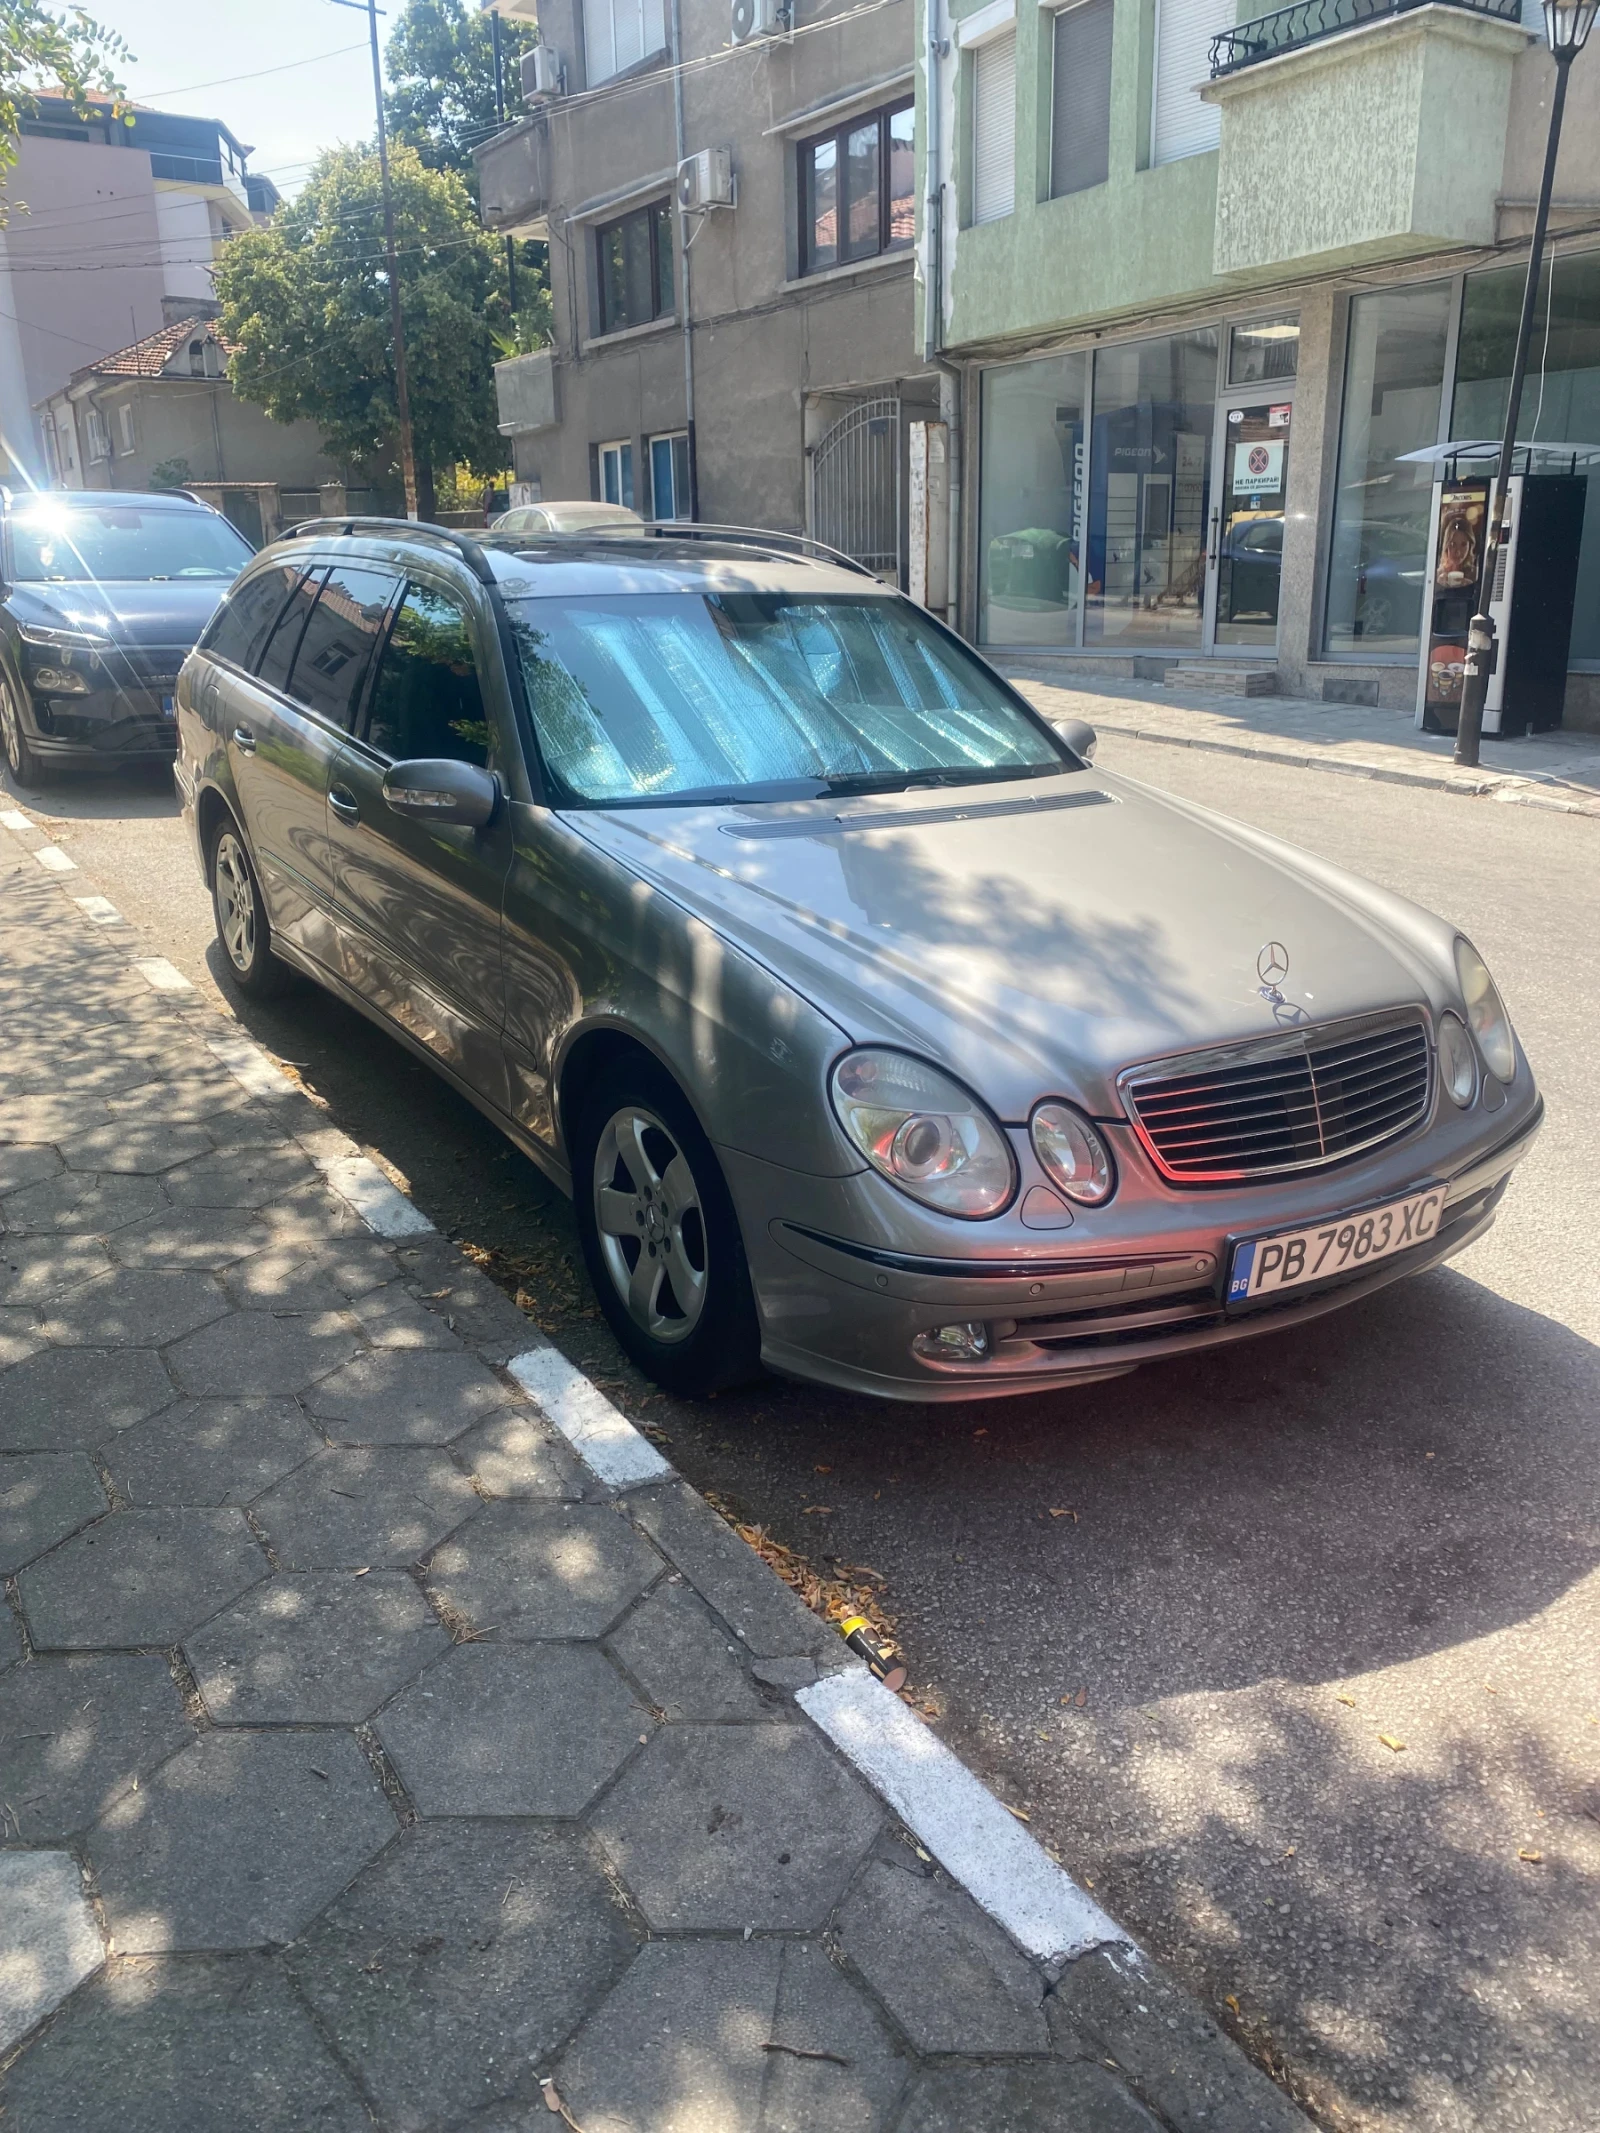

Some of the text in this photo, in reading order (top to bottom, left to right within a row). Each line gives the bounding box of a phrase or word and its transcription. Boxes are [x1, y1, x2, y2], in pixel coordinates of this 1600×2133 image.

[1255, 1195, 1438, 1288] PB 7983 XC
[1231, 1278, 1248, 1293] BG
